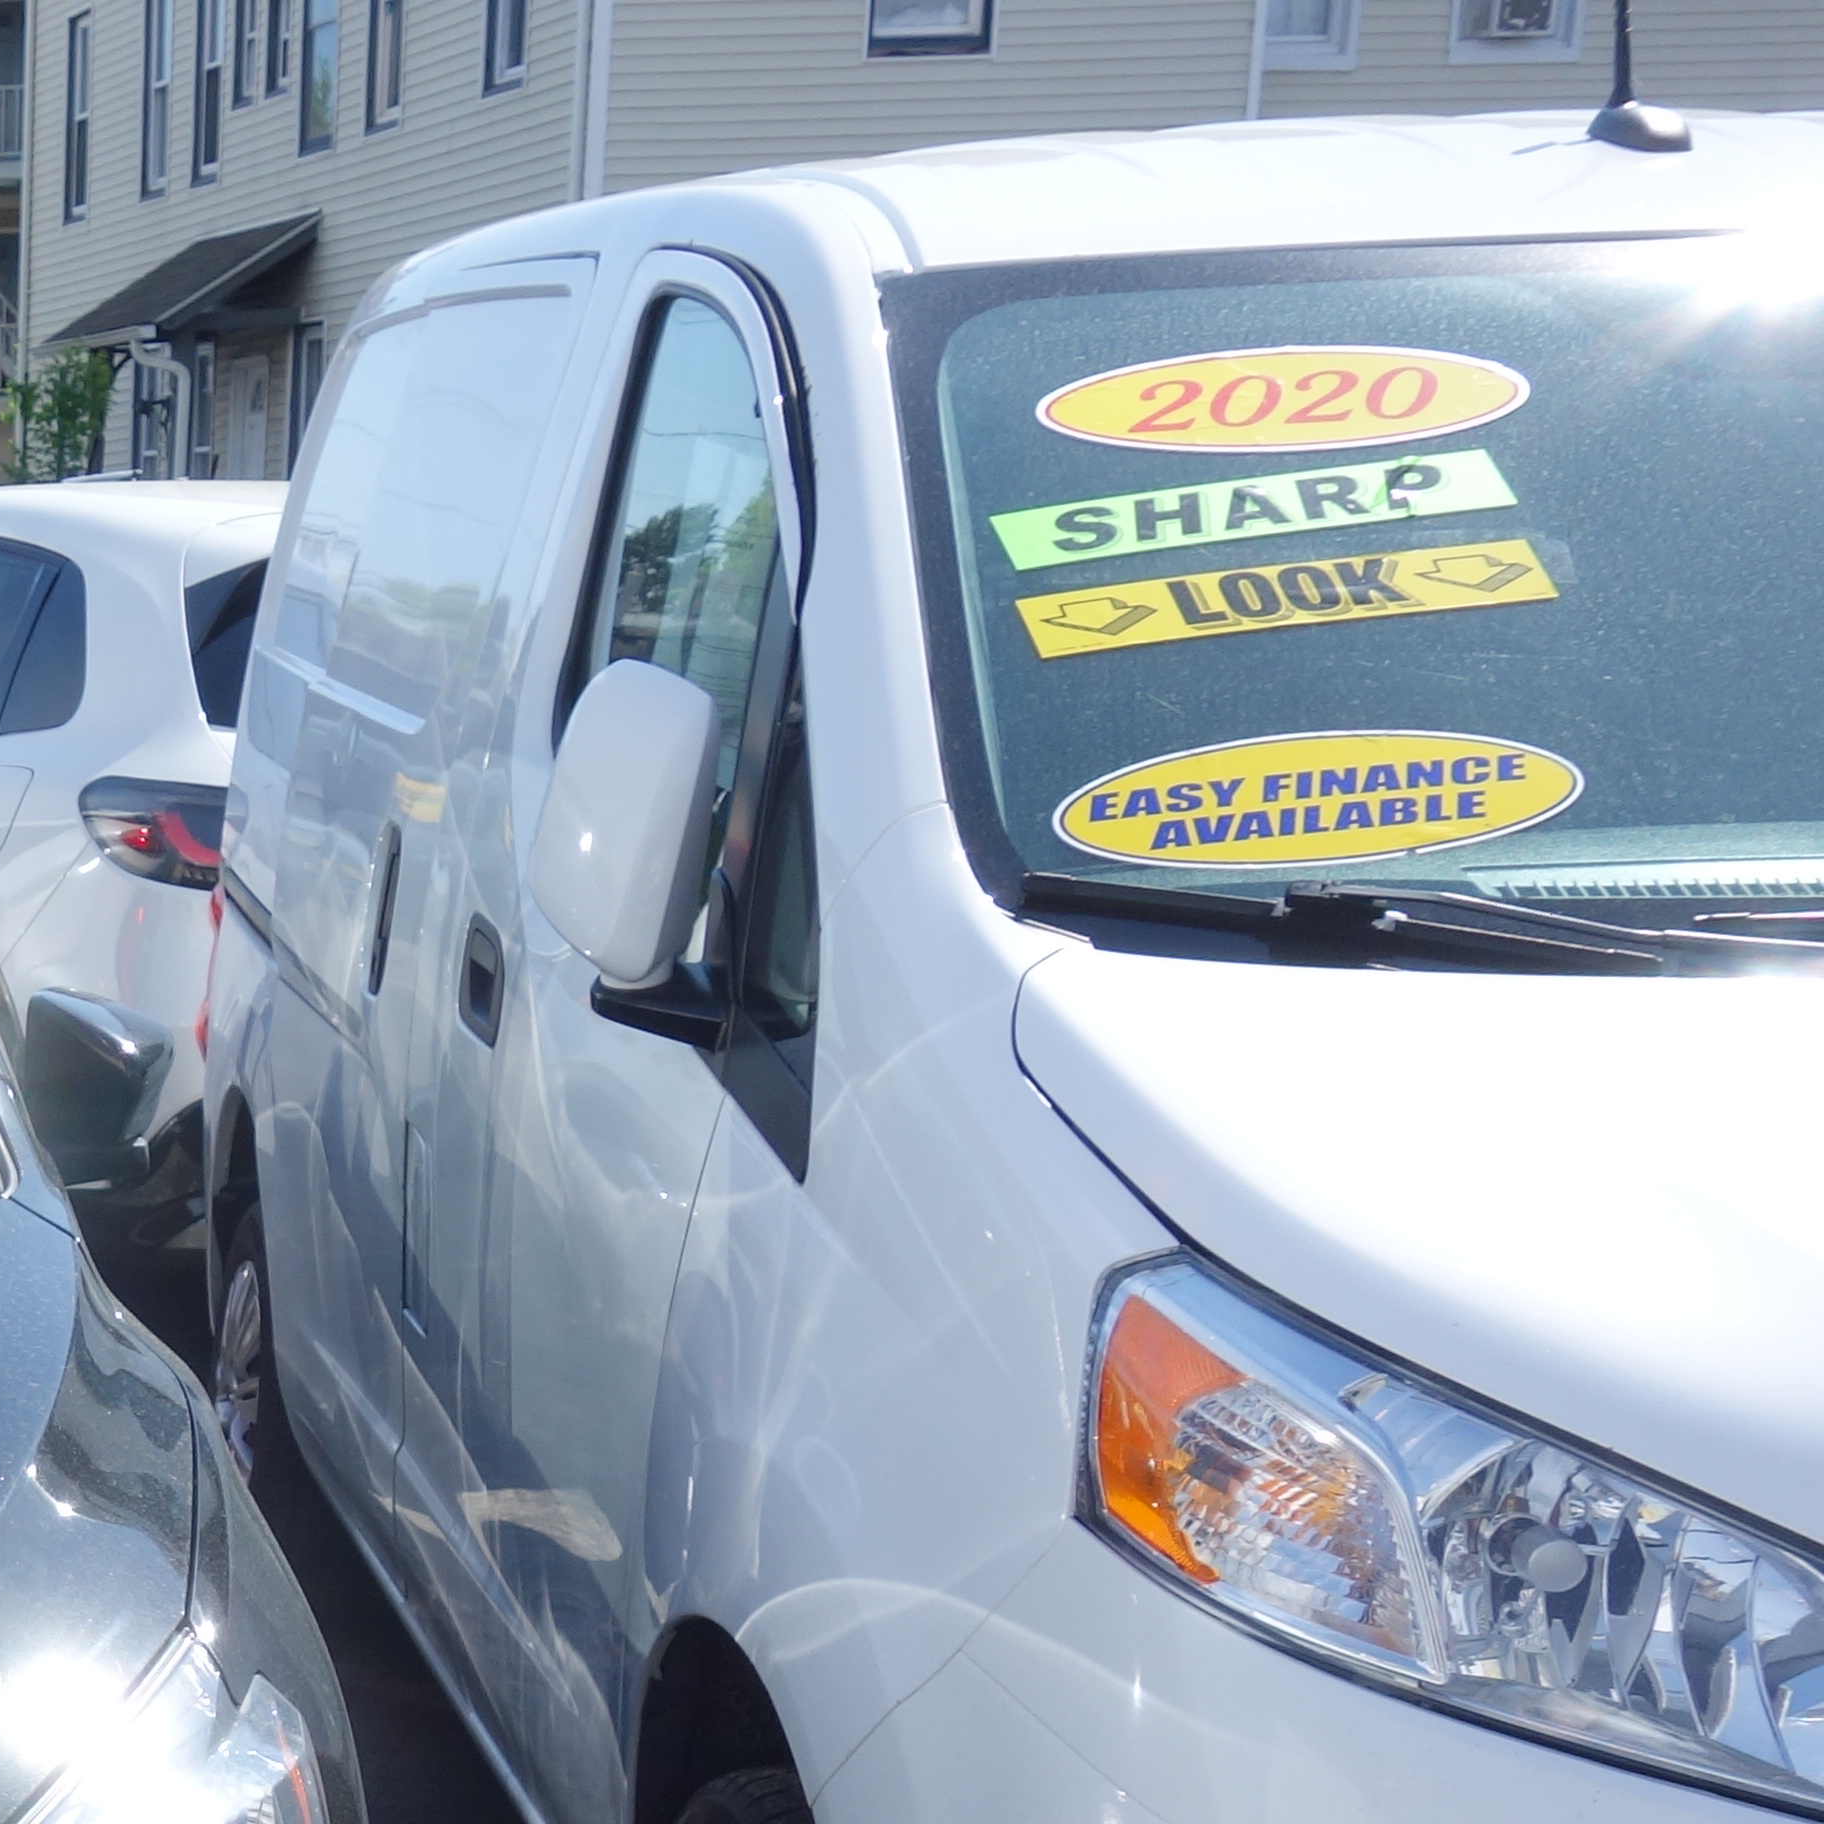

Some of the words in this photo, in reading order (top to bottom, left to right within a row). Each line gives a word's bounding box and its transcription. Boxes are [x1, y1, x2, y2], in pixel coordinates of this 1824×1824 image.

[1127, 366, 1439, 434] 2020
[1052, 463, 1449, 553] SHARP
[1165, 556, 1424, 630] LOOK
[1087, 777, 1243, 825] EASY
[1261, 752, 1528, 803] FINANCE
[1148, 791, 1487, 851] AVAILABLE
